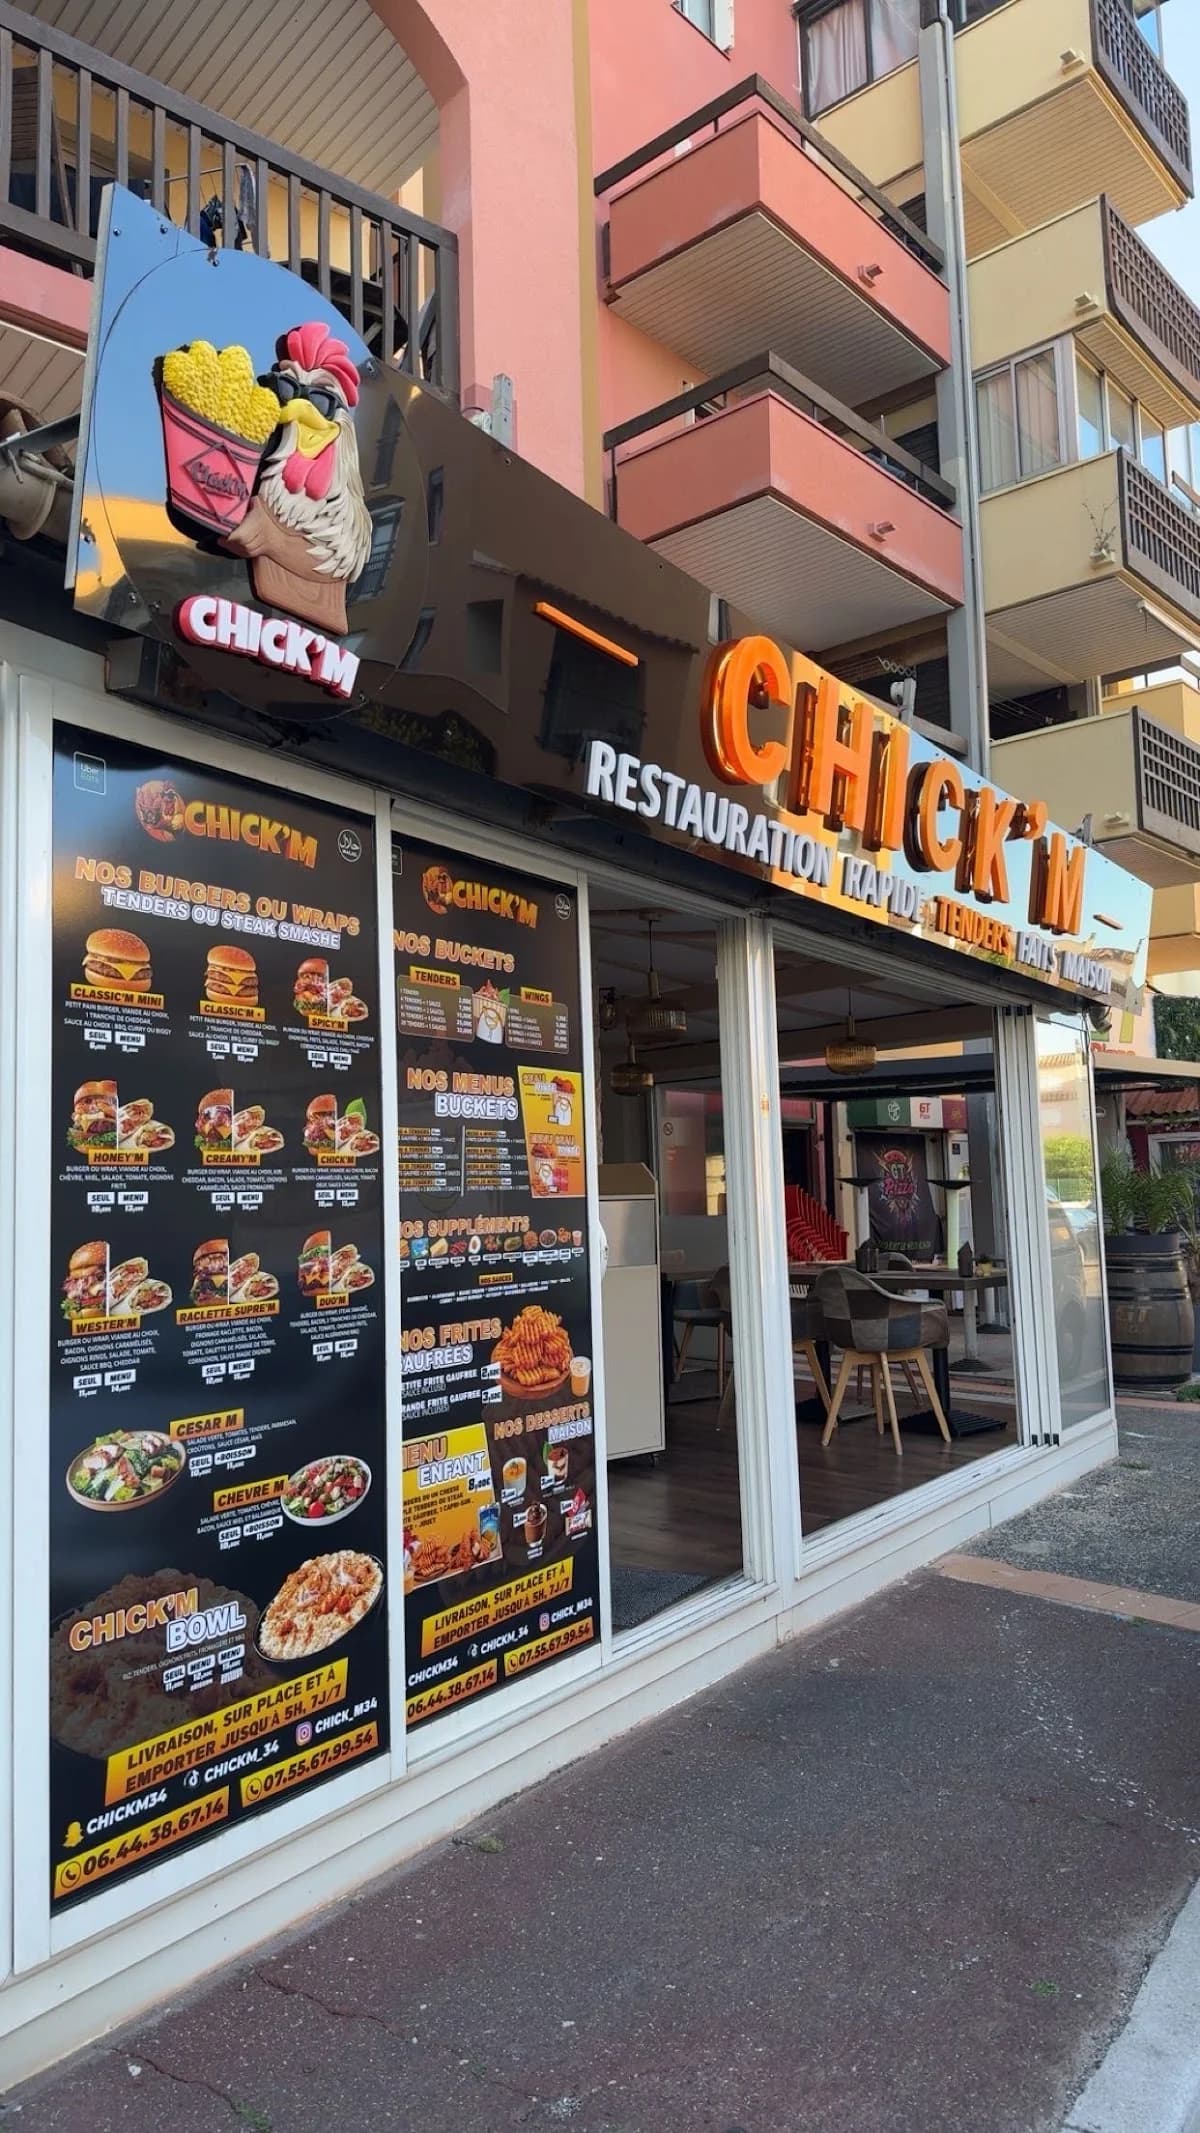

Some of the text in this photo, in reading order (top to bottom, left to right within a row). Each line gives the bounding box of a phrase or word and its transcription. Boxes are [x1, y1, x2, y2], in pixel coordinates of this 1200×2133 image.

[178, 594, 360, 698] CHICK'M
[700, 635, 1086, 935] CHICK'M
[184, 800, 320, 869] CHICK'M
[585, 740, 833, 887] RESTAURATION
[934, 895, 1012, 958] TENDERS
[1016, 931, 1058, 972] FAITS
[1061, 952, 1112, 994] MAISON
[75, 856, 360, 936] NOS BURGERS OU WRAPS
[452, 880, 539, 929] CHICK'M
[101, 886, 341, 949] TENDERS OU STEAK SMASHE
[392, 929, 515, 974] NOS BUCKETS
[415, 971, 457, 986] TENDERS
[74, 987, 161, 1006] CLASSIC'M MINI
[204, 1004, 254, 1017] CLASSIC'M
[525, 992, 549, 1003] WINGS
[64, 1018, 82, 1026] SAUCE
[312, 1018, 345, 1029] SPICY'M
[120, 1035, 141, 1043] MENU
[407, 1067, 448, 1091] NOS
[452, 1072, 515, 1097] MENUS
[434, 1092, 518, 1120] BUCKETS
[919, 1103, 930, 1114] GT
[94, 1153, 144, 1162] HONEY'M
[206, 1154, 257, 1163] CREAMY'M
[91, 1194, 111, 1202] SEUL
[400, 1214, 530, 1239] OS SUPPLÉMENTS
[180, 1303, 276, 1322] RACLETTE SUPRE'M
[320, 1296, 346, 1306] DUO'M
[76, 1318, 137, 1333] WESTER'M
[439, 1317, 502, 1347] FRITES
[80, 1363, 98, 1371] SAUCE
[206, 1362, 251, 1374] SEUL MENU
[401, 1343, 473, 1375] AUFRÉES
[78, 1372, 132, 1386] SEUL MENU
[423, 1375, 445, 1384] FRITE
[445, 1369, 478, 1382] GAUFREE
[427, 1396, 449, 1408] FRITE
[449, 1390, 481, 1403] GAUFREE
[176, 1414, 237, 1437] CESAR M
[494, 1401, 590, 1440] NOS DESSERTS
[547, 1417, 592, 1443] MAISON
[191, 1458, 211, 1468] SEUL
[418, 1451, 486, 1489] ENFANT
[218, 1480, 285, 1507] CHEVRE M
[221, 1530, 238, 1540] SEUL
[435, 1563, 565, 1631] LIVRAISON, SUR PLACE ET À
[69, 1587, 199, 1652] CHICK'M
[167, 1601, 247, 1653] BOWL
[434, 1617, 490, 1650] EMPORTER
[550, 1579, 569, 1597] 7J/7
[518, 1623, 590, 1665] 07.55.67.99.54
[164, 1670, 184, 1681] SEUL
[190, 1659, 212, 1671] MENU
[221, 1648, 242, 1659] MENU
[408, 1656, 459, 1687] CHICKM34
[407, 1666, 495, 1718] 06.44.38.67.14
[127, 1665, 336, 1771] LIVRAISON, SUR PLACE ET À
[314, 1697, 378, 1735] CHICK_M34
[125, 1742, 216, 1794] EMPORTER
[310, 1684, 343, 1709] 7J/7
[203, 1739, 280, 1783] CHICKM_34
[263, 1727, 374, 1793] 07.55.67.99.54
[86, 1787, 169, 1834] CHICKM34
[83, 1796, 224, 1877] 06.44.38.67.14
